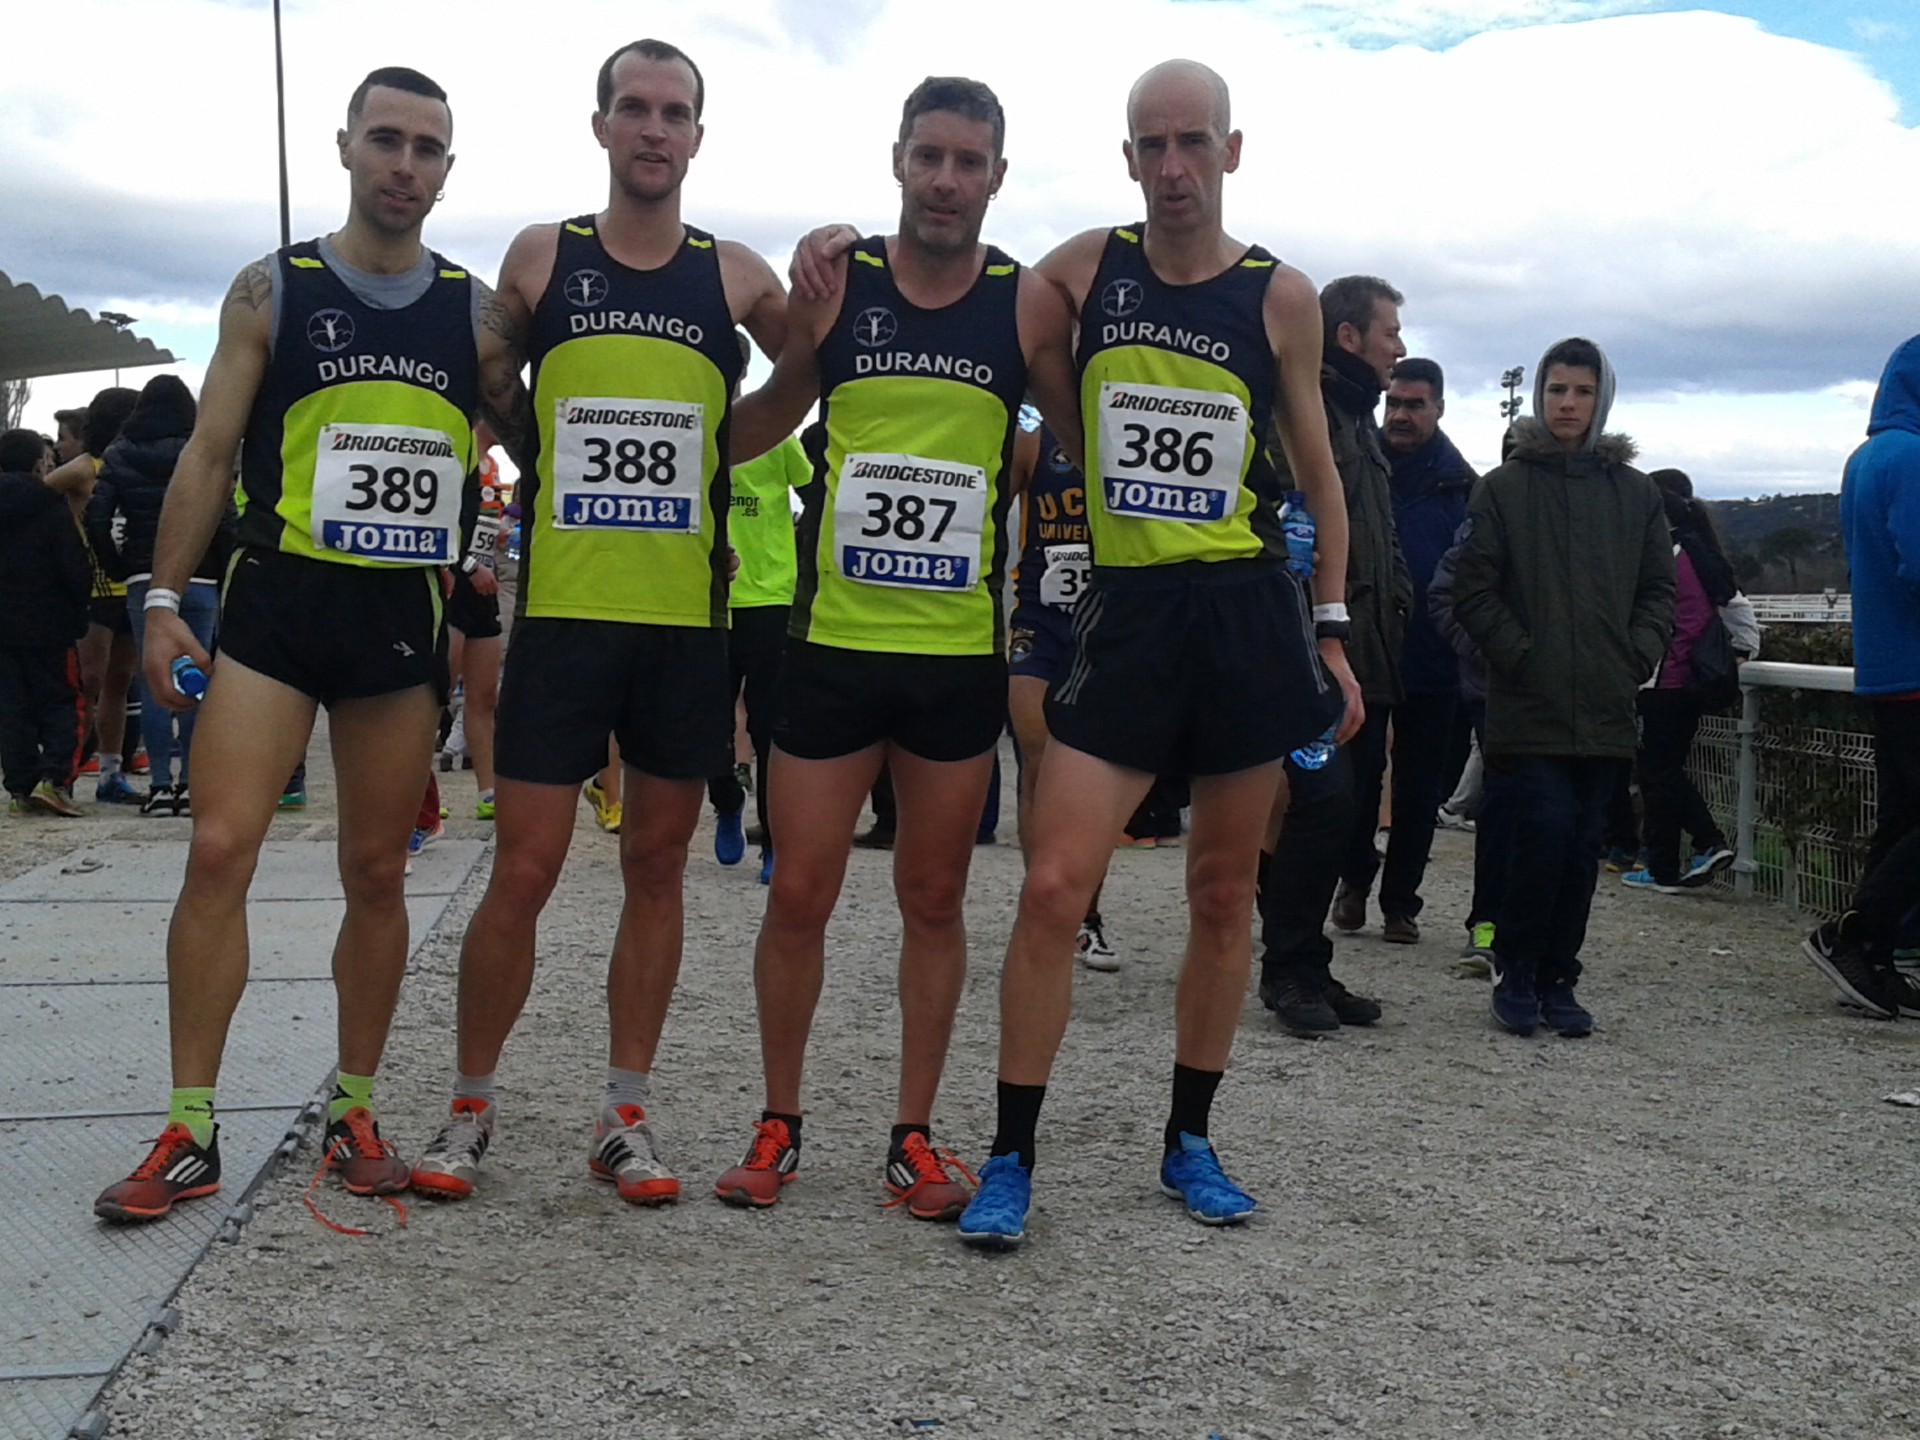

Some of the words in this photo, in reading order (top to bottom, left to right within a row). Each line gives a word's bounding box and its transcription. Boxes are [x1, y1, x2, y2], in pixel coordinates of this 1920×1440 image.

[569, 310, 704, 345] DURANGO
[1102, 321, 1230, 362] DURANGO
[317, 354, 449, 391] DURANGO
[855, 351, 993, 385] DURANGO
[566, 406, 696, 430] BRIDGESTONE
[1109, 391, 1240, 422] BRIDGESTONE
[581, 437, 677, 486] 388
[1117, 423, 1215, 477] 386
[345, 464, 439, 516] 389
[851, 461, 978, 490] BRIDGESTONE
[860, 492, 958, 543] 387
